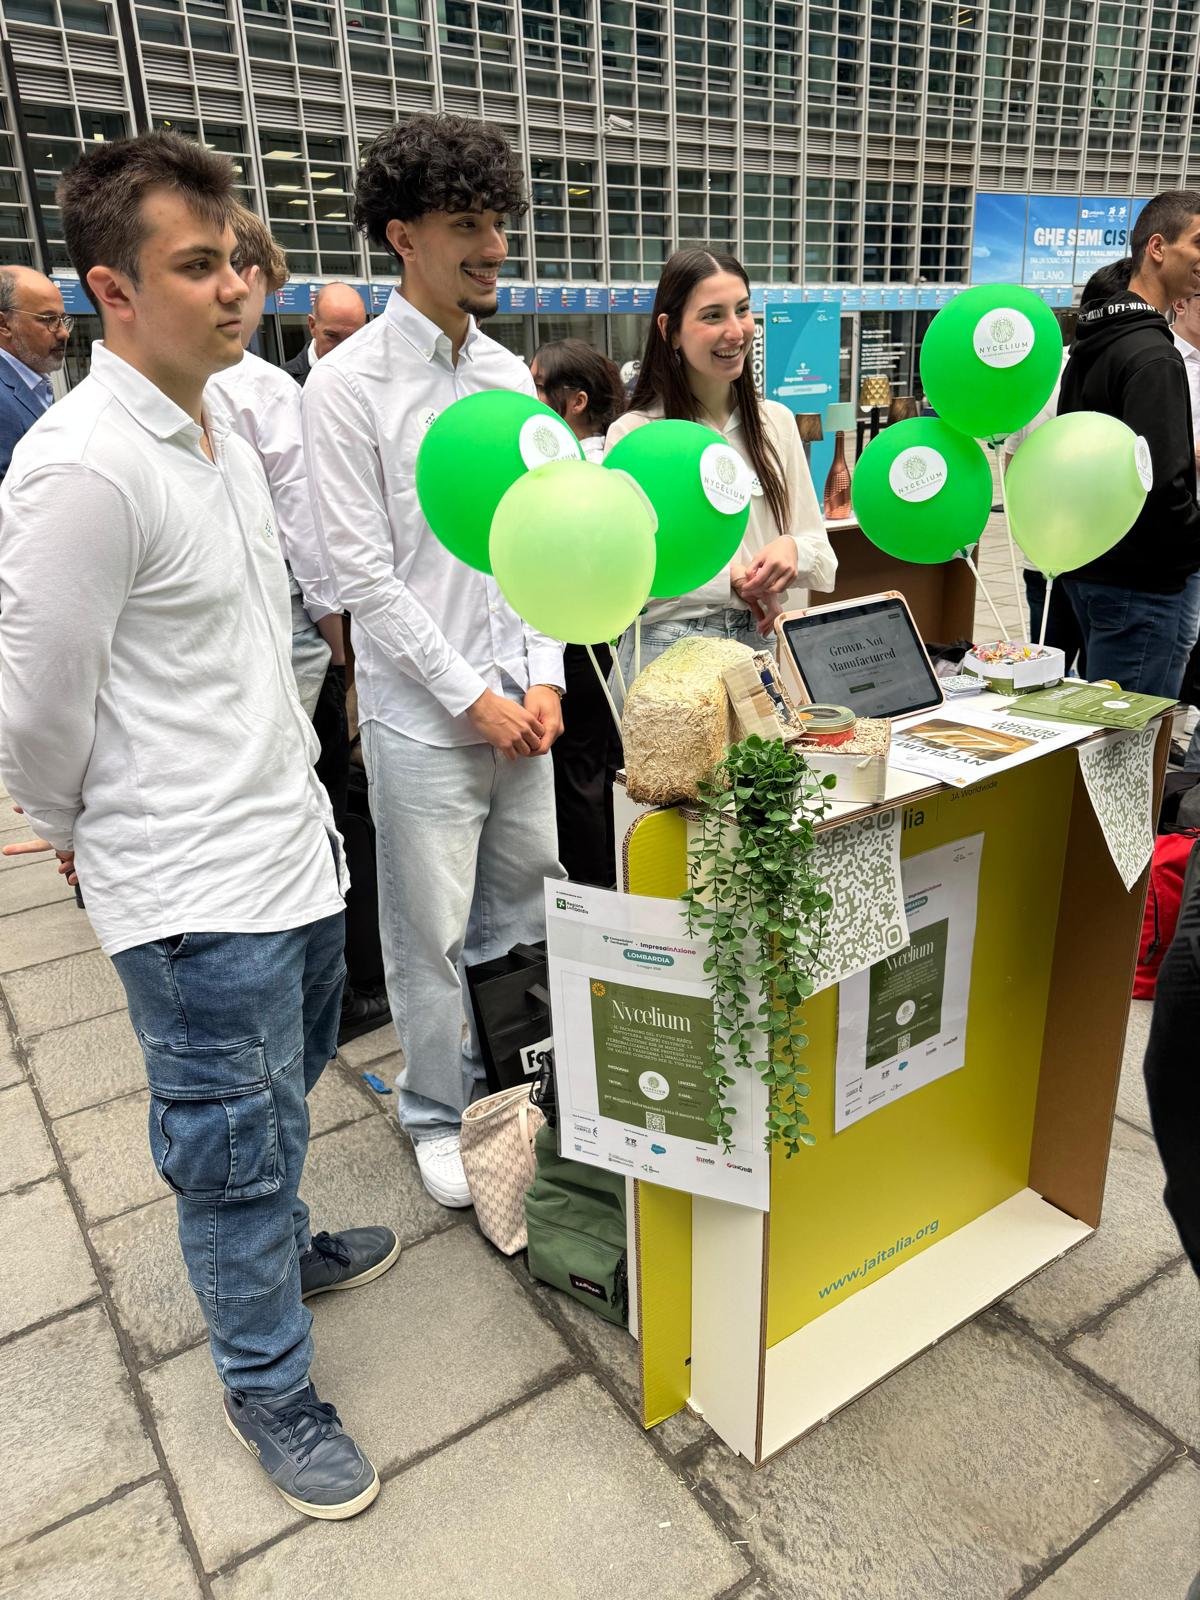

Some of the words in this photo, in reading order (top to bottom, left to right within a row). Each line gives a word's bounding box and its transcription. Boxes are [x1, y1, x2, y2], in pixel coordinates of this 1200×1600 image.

[1033, 227, 1065, 246] GHE
[1032, 270, 1065, 281] MILANO
[979, 341, 1029, 354] NYCELIUM
[704, 476, 745, 502] NYCELIUM
[898, 471, 944, 495] NYCELIUM
[866, 636, 884, 648] Not
[828, 648, 897, 673] Manufactured
[991, 722, 1053, 740] ANNUAL
[997, 720, 1061, 737] REPORT
[894, 740, 987, 767] NYCELIUM
[902, 808, 926, 832] lia
[626, 951, 670, 964] LOMBARDIA
[610, 999, 692, 1032] Nycelium
[818, 1219, 940, 1299] www.jaitalia.org
